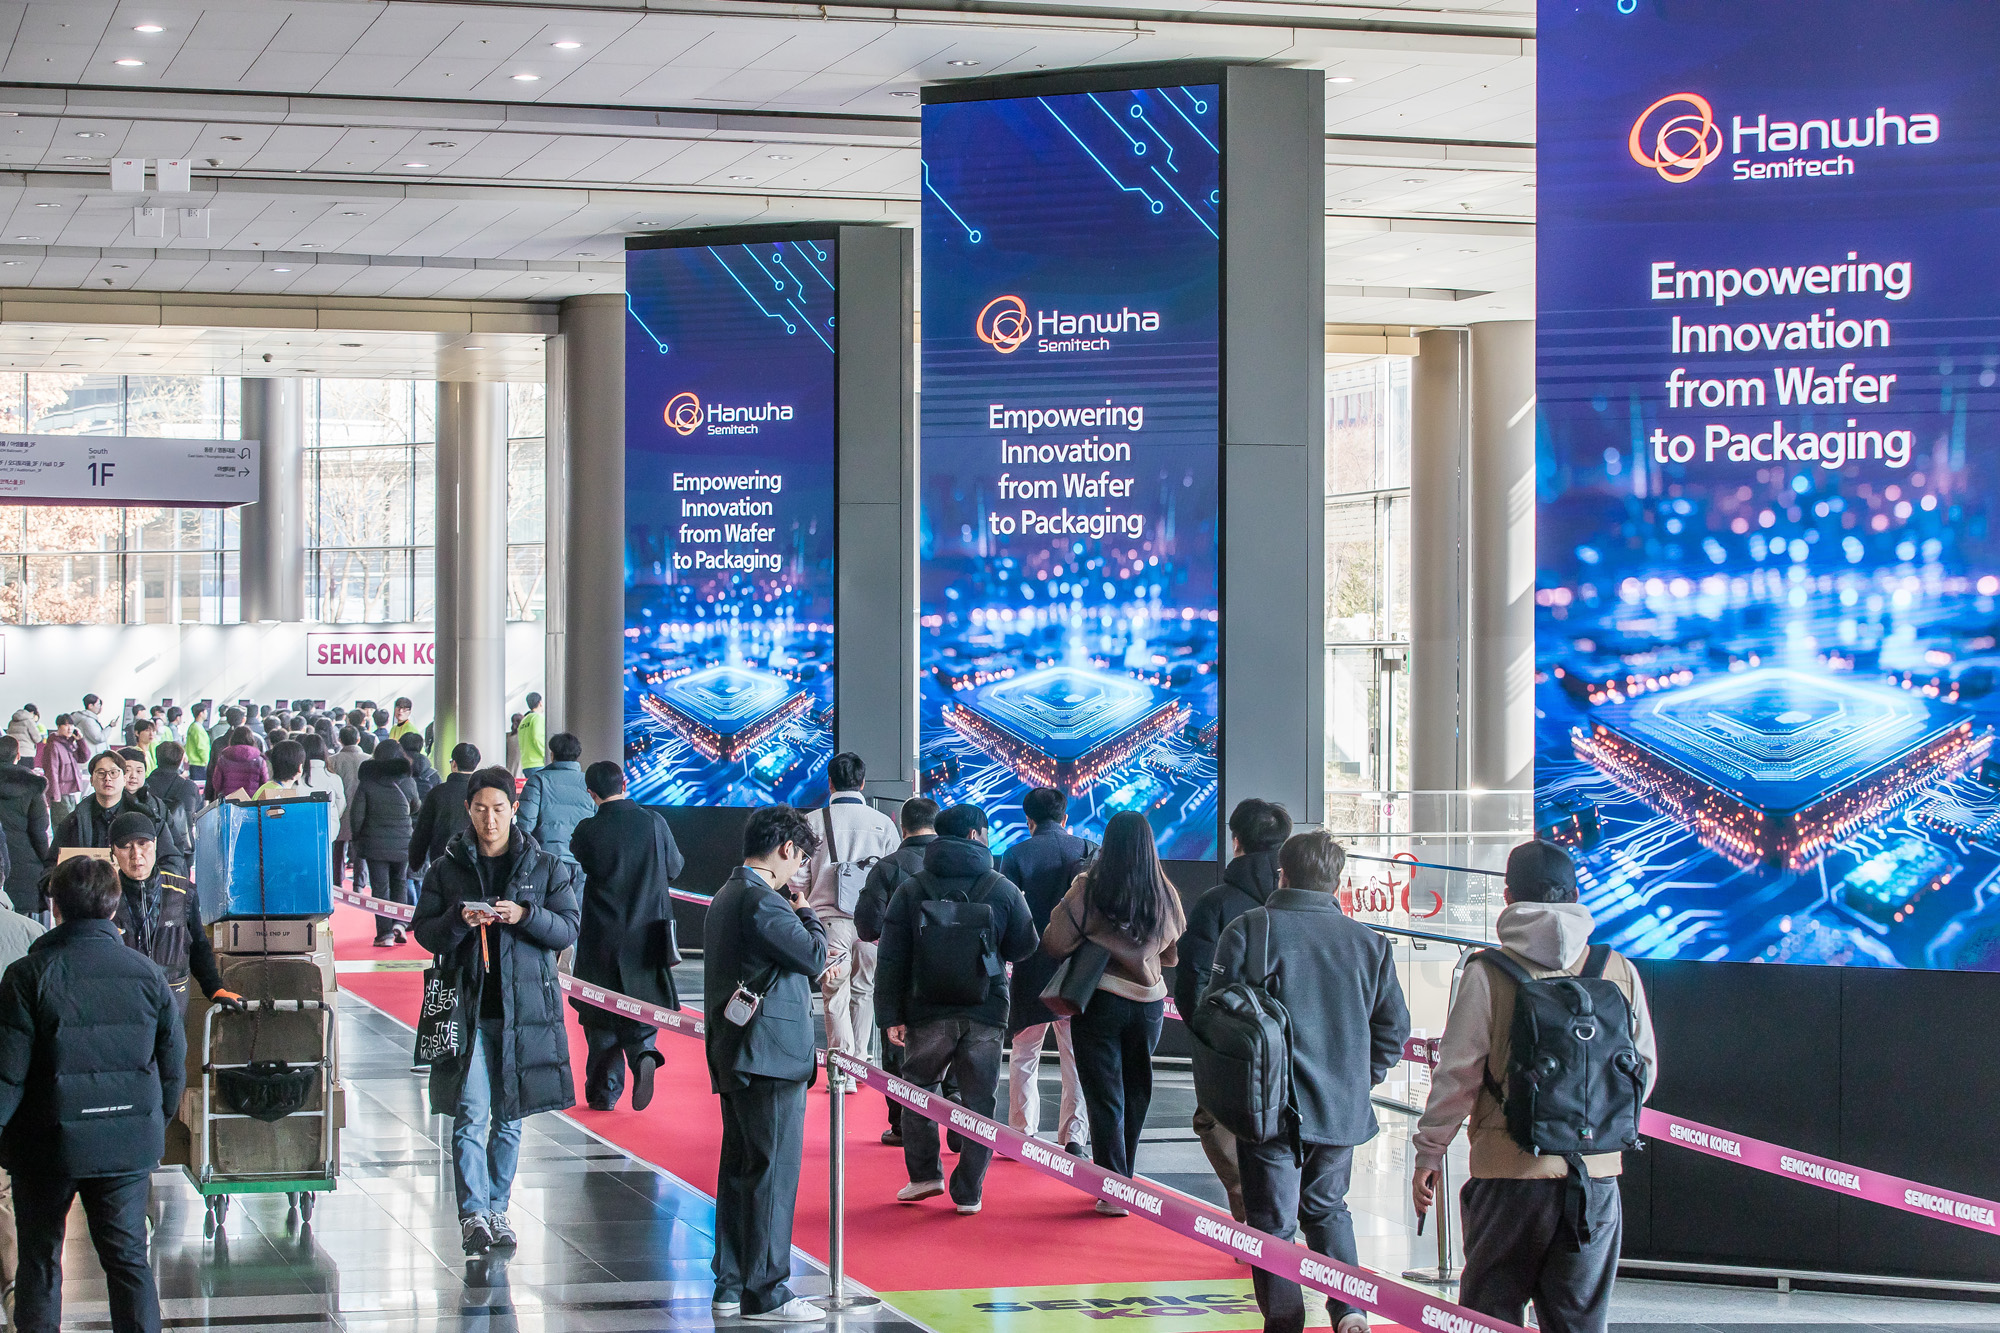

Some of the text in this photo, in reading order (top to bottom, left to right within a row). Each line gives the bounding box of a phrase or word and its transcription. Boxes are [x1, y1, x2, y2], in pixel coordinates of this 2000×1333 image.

[1732, 107, 1940, 154] Hanwha
[1733, 155, 1854, 181] Semitech
[1651, 251, 1911, 306] Empowering
[1038, 307, 1160, 335] Hanwha
[1671, 308, 1890, 353] Innovation
[1038, 337, 1110, 353] Semitech
[1665, 363, 1897, 408] from Wafer
[707, 402, 794, 423] Hanwha
[989, 399, 1144, 434] Empowering
[707, 424, 759, 435] Semitech
[1650, 419, 1911, 469] to Packaging
[88, 447, 108, 455] South
[1001, 436, 1131, 464] Innovation
[88, 462, 116, 487] 1F
[672, 470, 782, 494] Empowering
[998, 471, 1135, 499] from Wafer
[681, 496, 773, 517] Innovation
[679, 522, 776, 543] from Wafer
[989, 507, 1143, 539] to Packaging
[672, 549, 782, 573] to Packaging
[318, 643, 405, 664] SEMICON
[435, 1021, 458, 1035] THE
[887, 1078, 930, 1110] SEMICON KOREA
[950, 1108, 998, 1143] SEMICON KOREA
[1669, 1123, 1742, 1158] SEMICON KOREA
[1021, 1141, 1076, 1178] SEMICON KOREA
[1780, 1155, 1861, 1192] SEMICON KOREA
[1102, 1177, 1163, 1216] SEMICON KOREA
[1904, 1189, 1996, 1227] SEMICON KOREA
[1194, 1215, 1264, 1259] SEMICON KOREA
[1299, 1257, 1379, 1305] SEMICON KOREA
